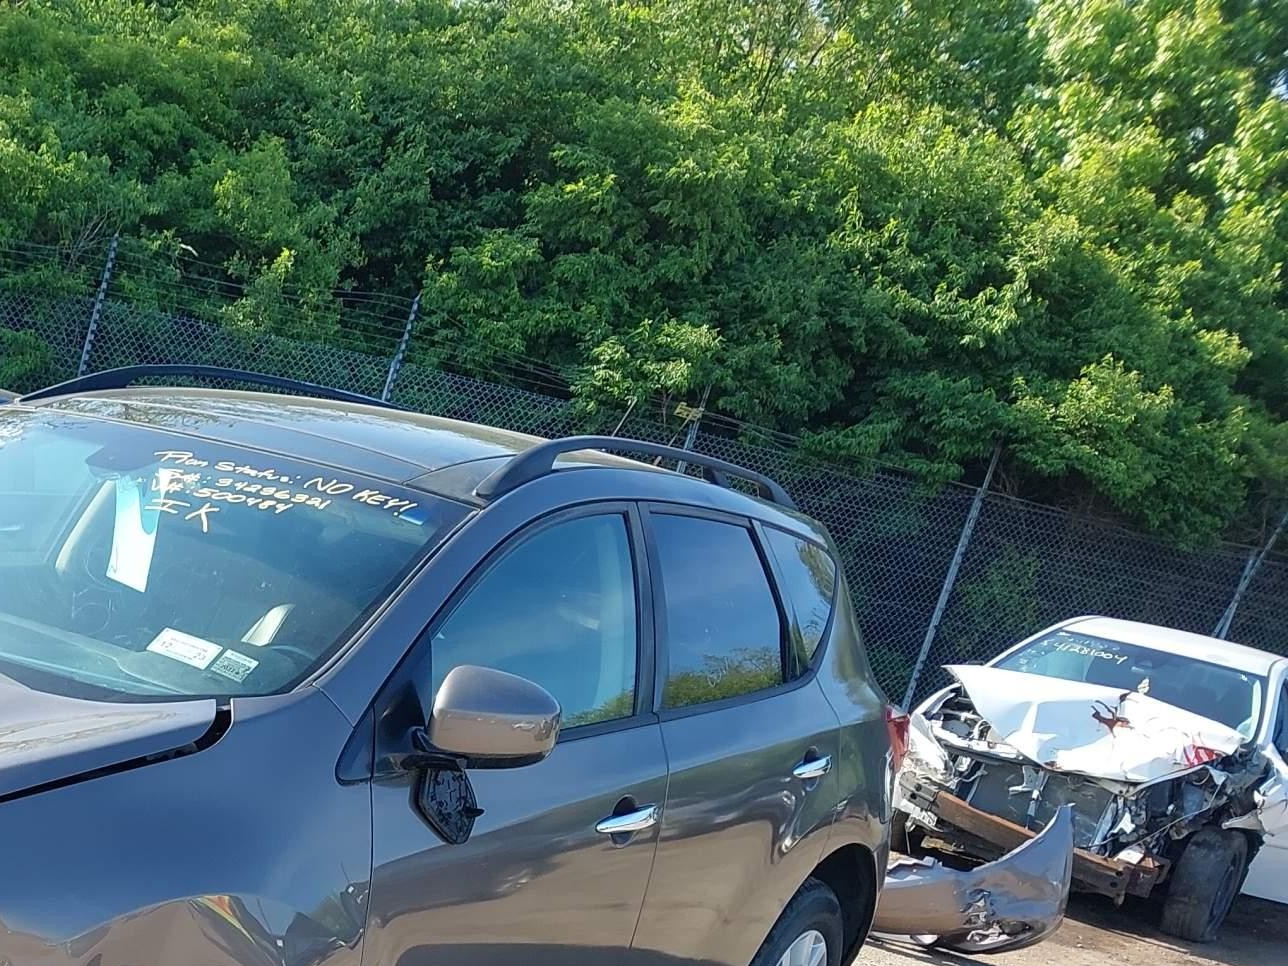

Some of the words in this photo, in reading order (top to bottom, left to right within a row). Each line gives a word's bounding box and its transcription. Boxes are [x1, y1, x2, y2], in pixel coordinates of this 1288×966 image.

[192, 487, 294, 514] 500484
[215, 478, 332, 510] 34236321
[303, 477, 355, 495] NO
[351, 489, 418, 516] KEY!
